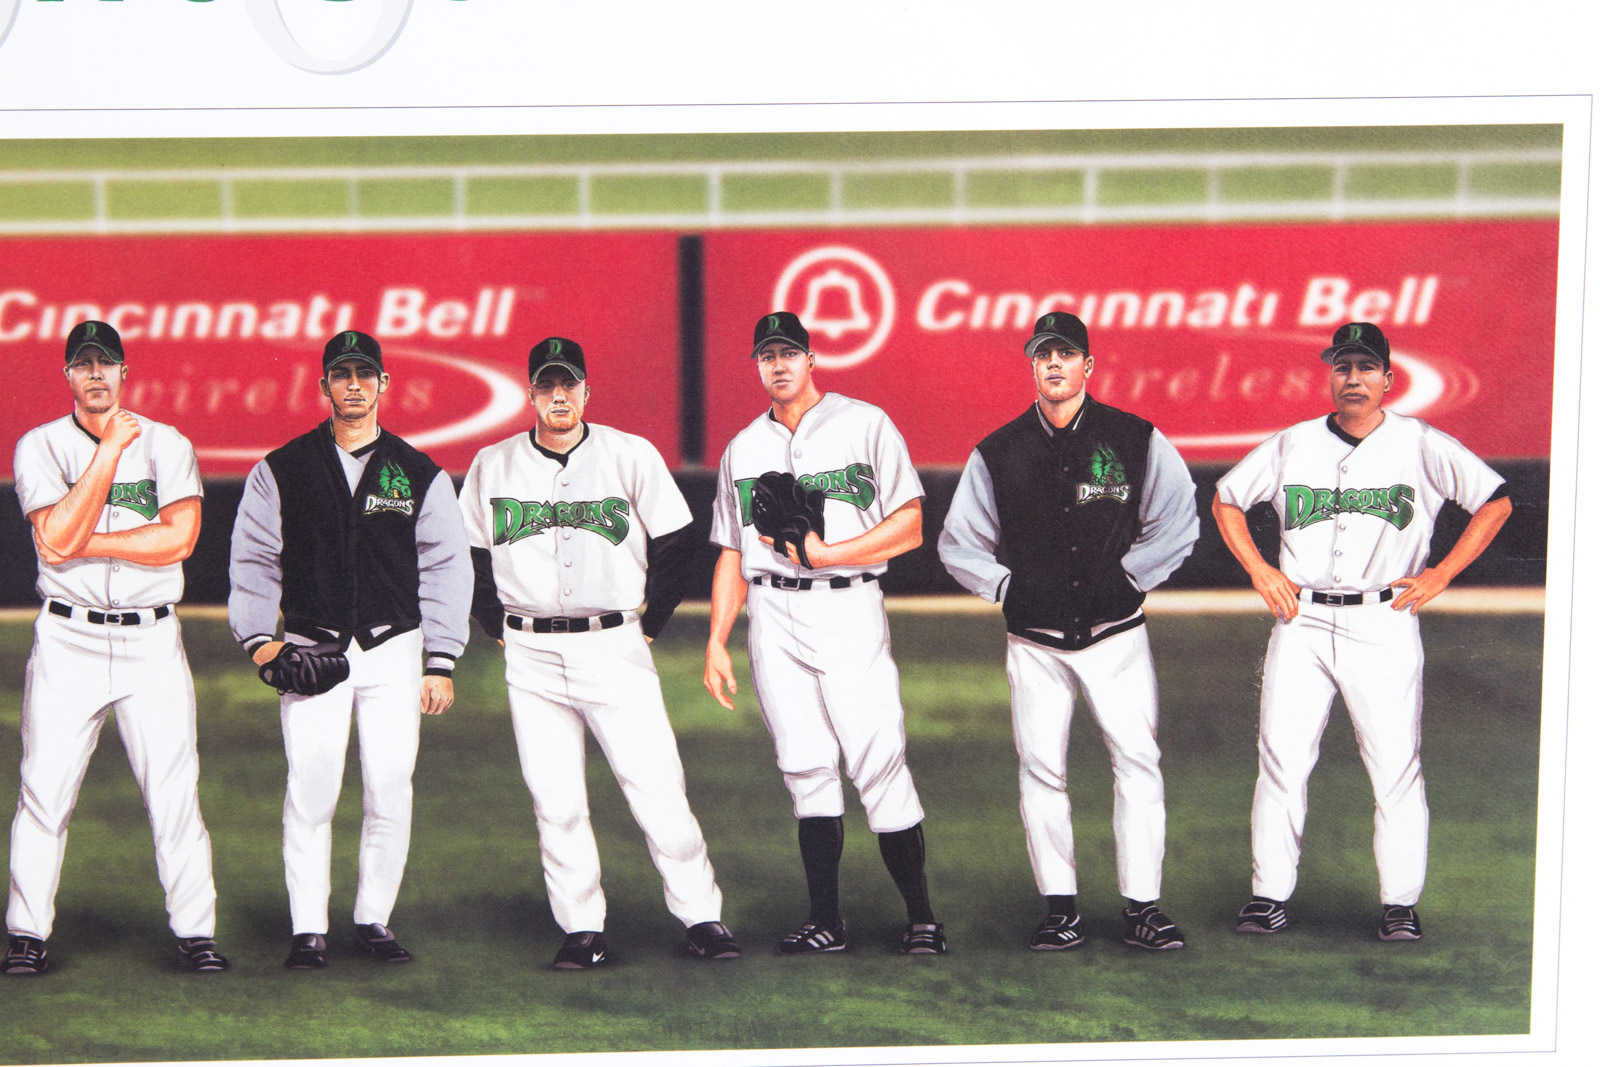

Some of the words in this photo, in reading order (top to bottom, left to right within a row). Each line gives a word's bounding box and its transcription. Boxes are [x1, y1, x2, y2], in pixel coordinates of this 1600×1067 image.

[0, 289, 352, 342] Cincinnati
[375, 286, 516, 338] Bell
[1299, 275, 1441, 325] Bell
[490, 497, 629, 546] DRAGONS
[1283, 484, 1415, 531] DRAGONS
